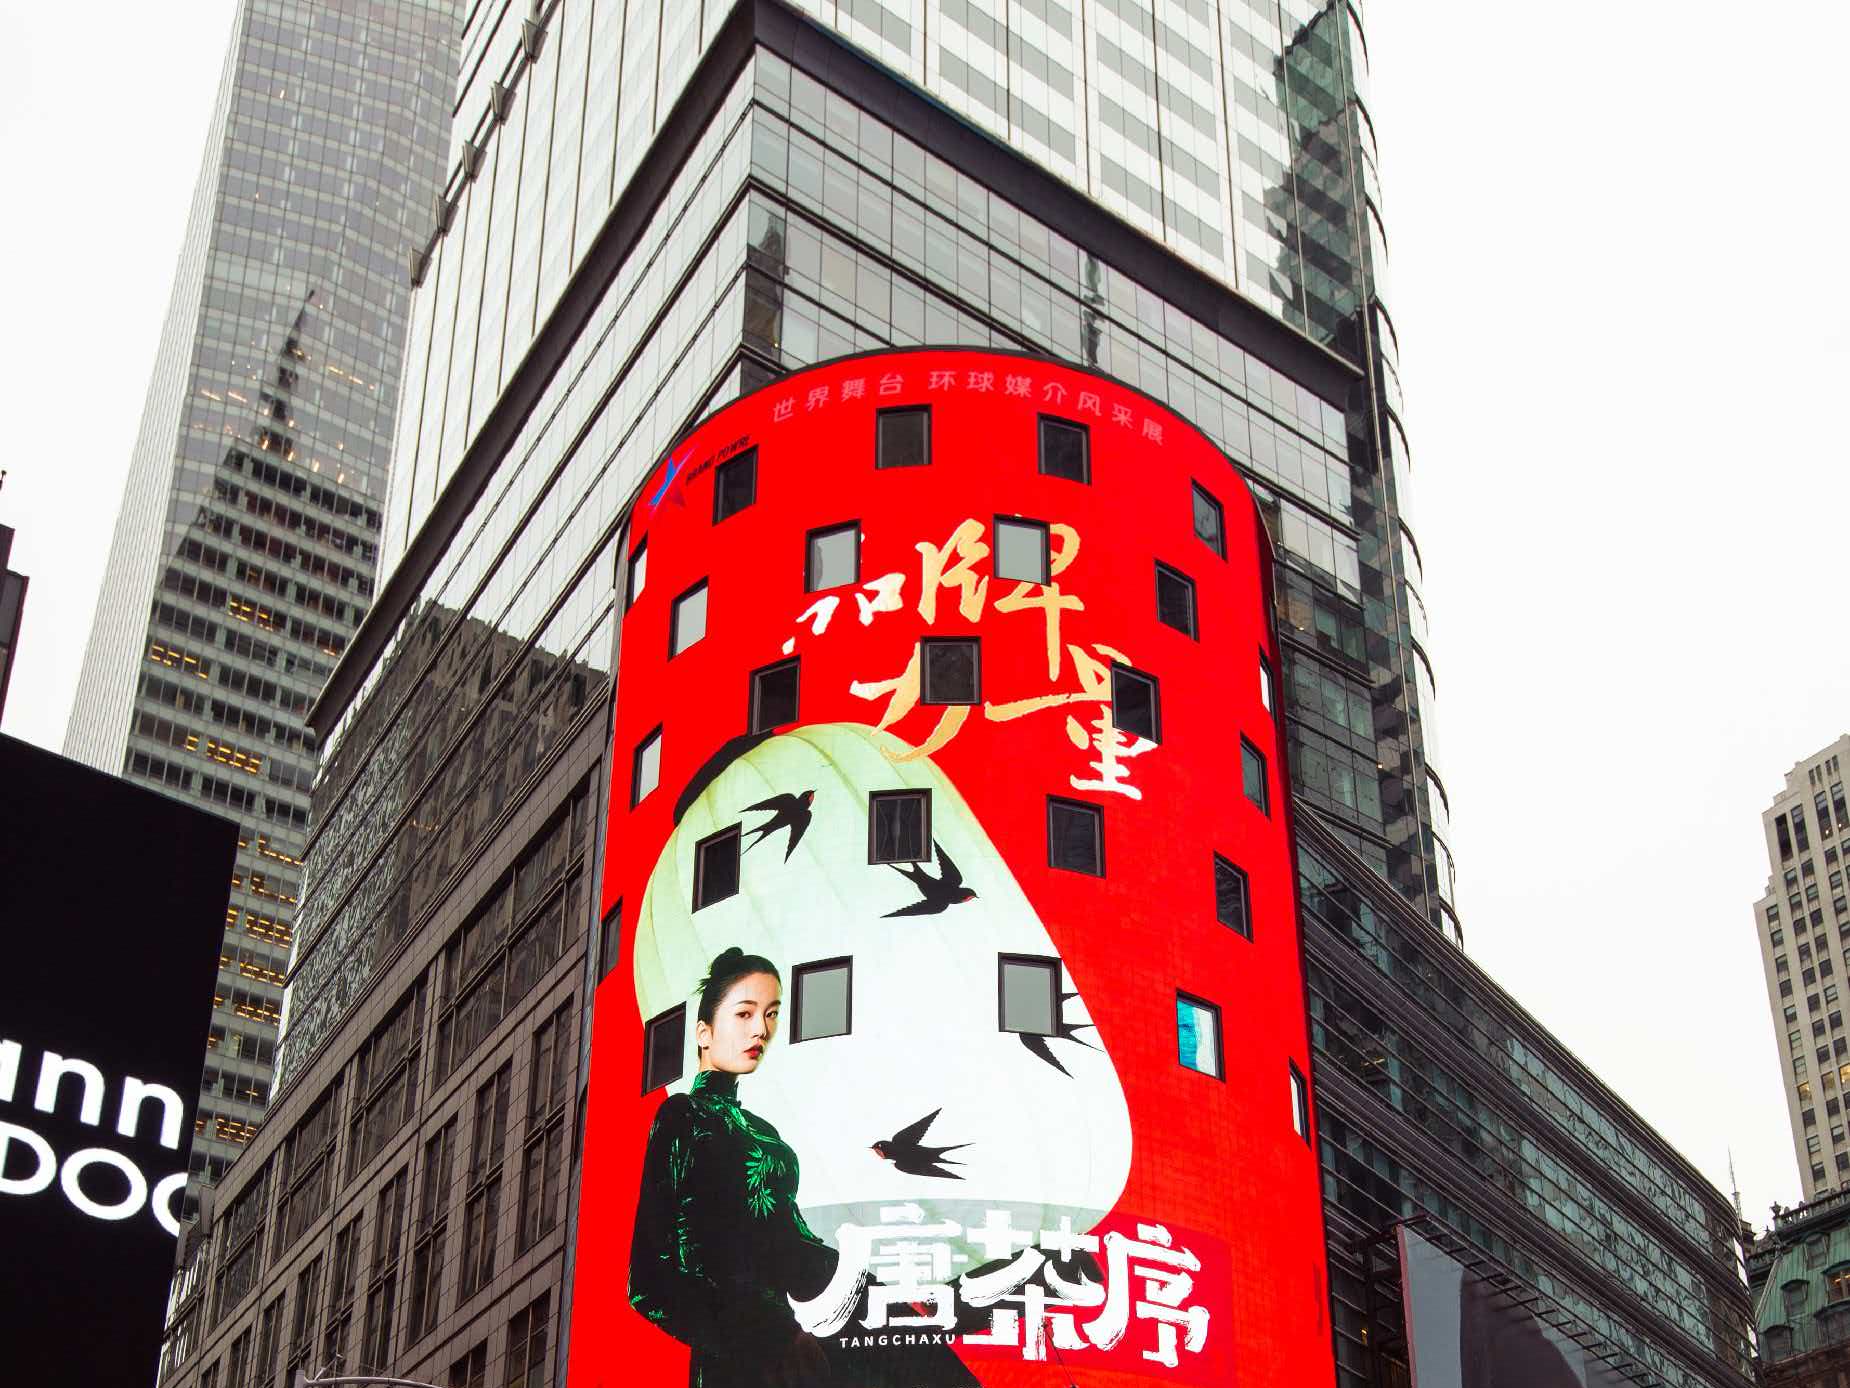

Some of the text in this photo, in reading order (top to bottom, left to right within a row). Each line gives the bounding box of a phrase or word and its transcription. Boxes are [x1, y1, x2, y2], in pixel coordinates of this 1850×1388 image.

[771, 370, 1164, 446] 世界舞台 环球媒介风采展
[787, 1202, 1209, 1368] 唐茶序
[840, 1332, 957, 1349] TANGCHAXU
